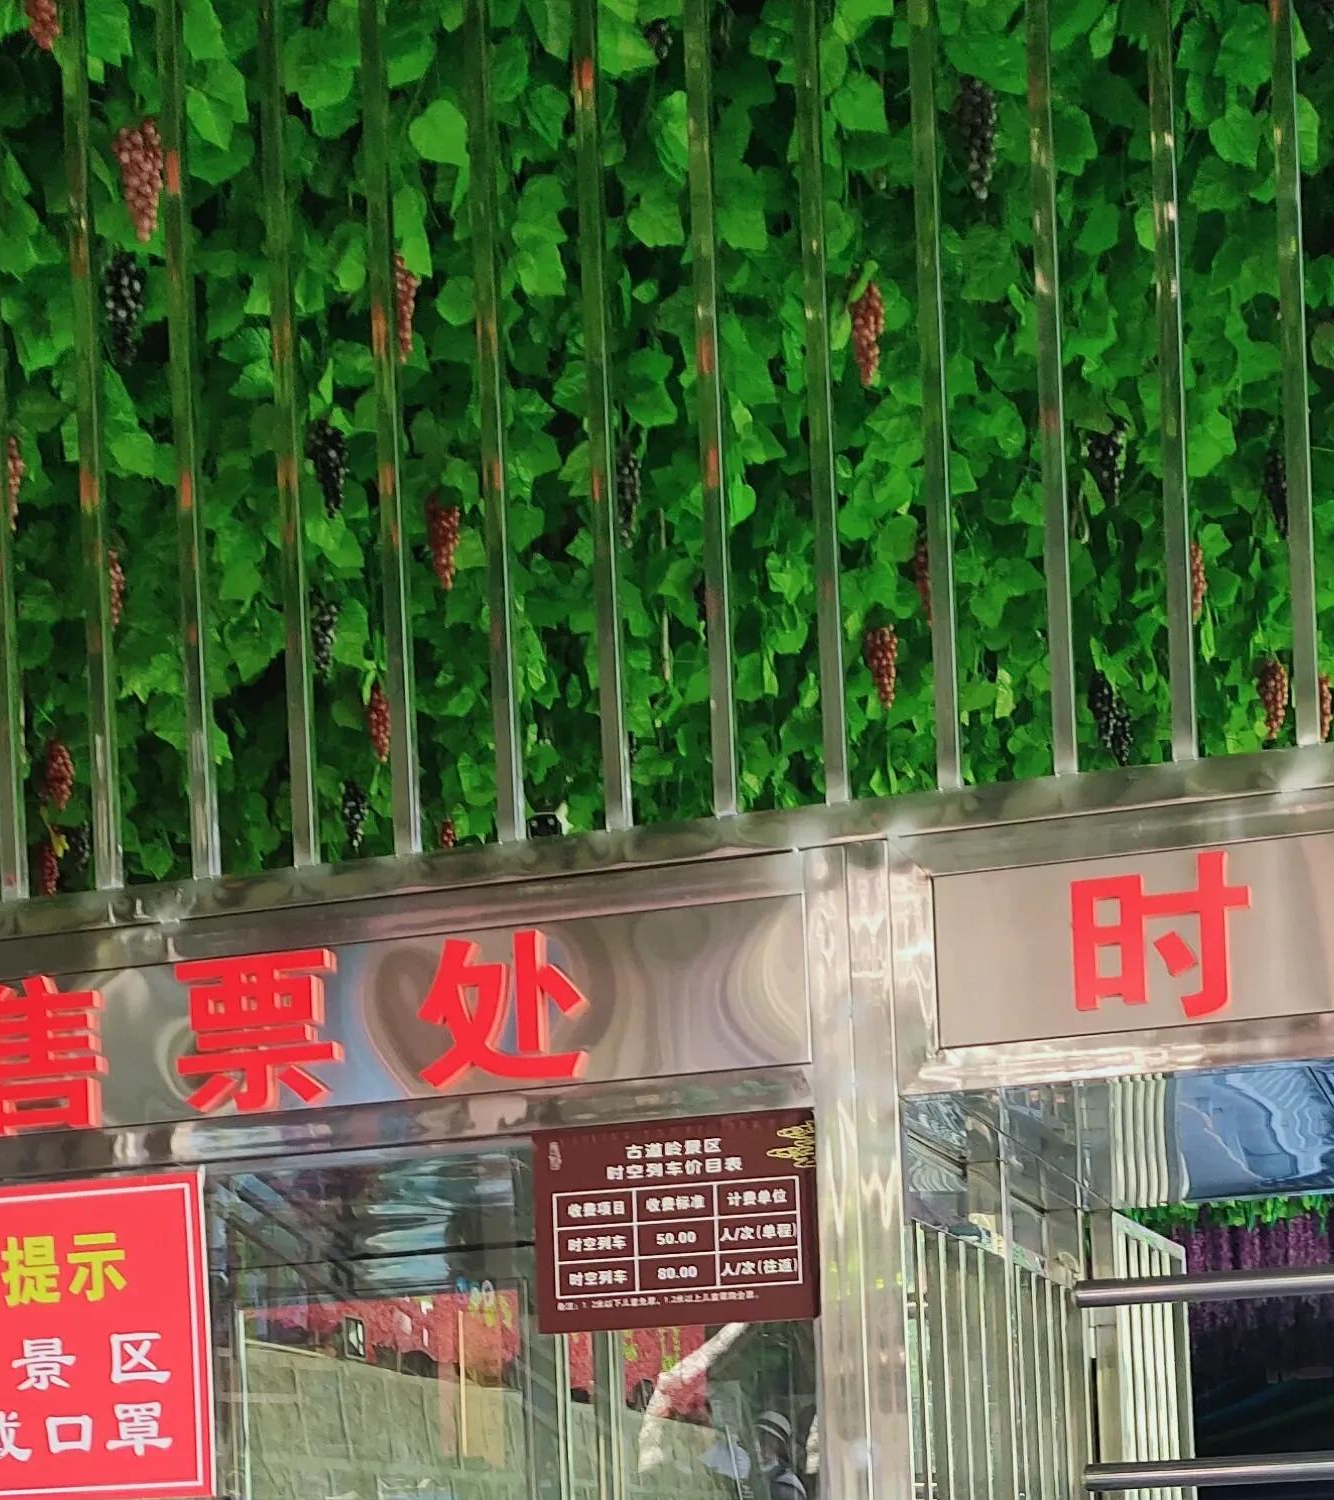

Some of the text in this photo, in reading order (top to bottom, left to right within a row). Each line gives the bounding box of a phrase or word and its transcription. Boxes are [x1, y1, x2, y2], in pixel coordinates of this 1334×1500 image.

[625, 1137, 722, 1160] 古道岭景区
[606, 1156, 744, 1181] 时空列车价目表
[567, 1188, 788, 1219] 收费项目 收费标准 计费单位
[567, 1235, 627, 1253] 时空列车
[656, 1231, 697, 1246] 50.00
[568, 1269, 628, 1287] 时空列车
[657, 1266, 698, 1280] 80.00
